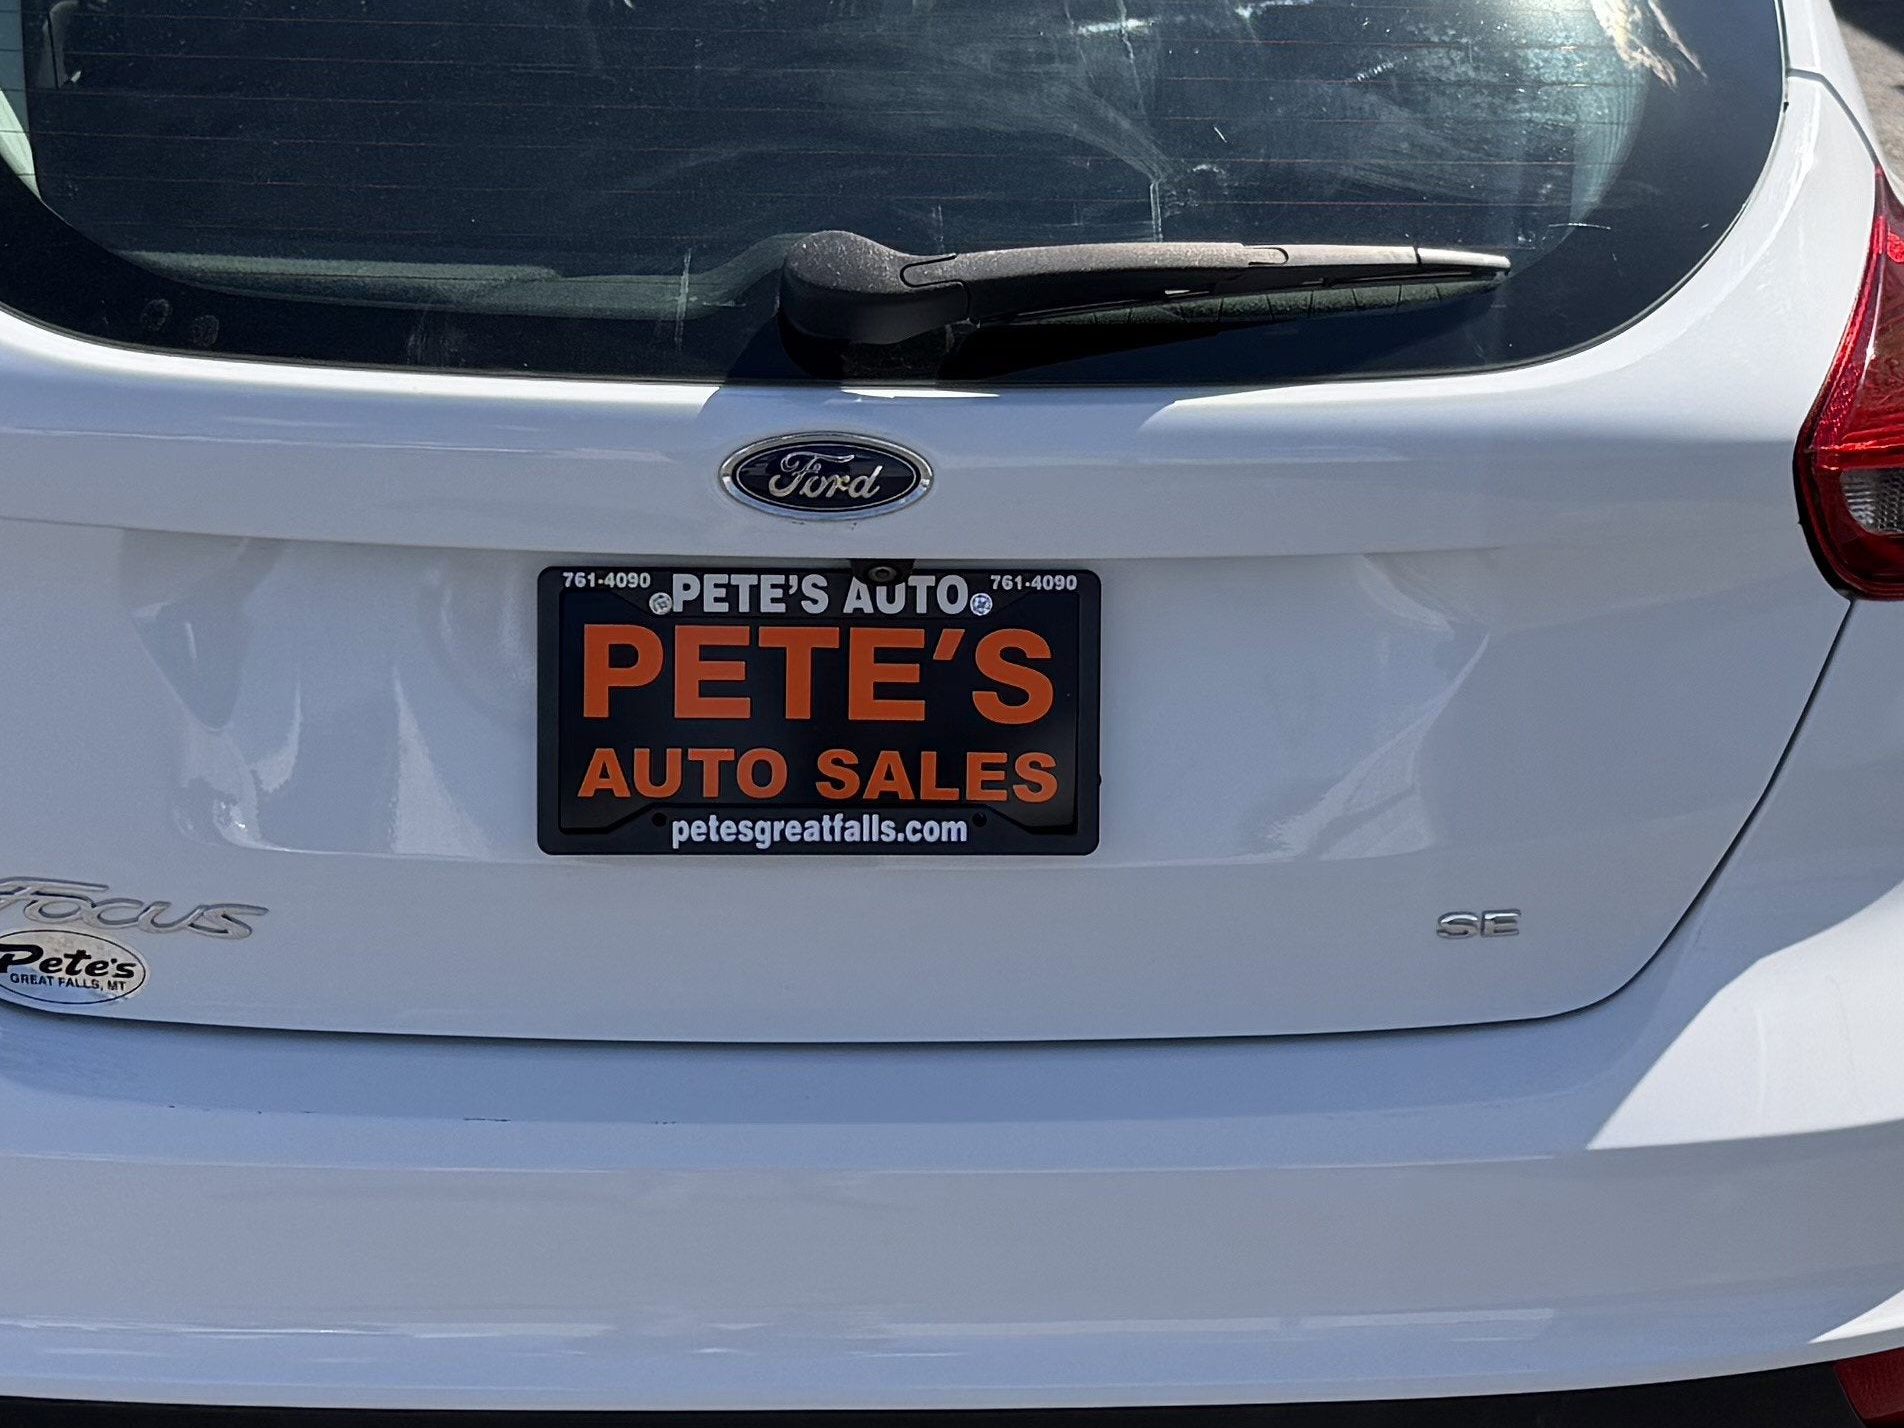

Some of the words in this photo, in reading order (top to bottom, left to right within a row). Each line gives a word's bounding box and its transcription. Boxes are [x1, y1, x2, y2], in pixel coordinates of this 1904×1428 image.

[768, 450, 883, 499] Ford
[672, 573, 829, 614] PETE'S
[842, 574, 969, 615] AUTO
[583, 624, 1055, 725] PETE'S
[577, 747, 788, 799] AUTO
[815, 748, 1059, 803] SALES
[671, 813, 968, 850] petesgreatfalls.com
[1437, 908, 1522, 939] SE
[10, 972, 54, 988] GREAT
[58, 976, 105, 992] FALLS,
[108, 978, 126, 992] MT
